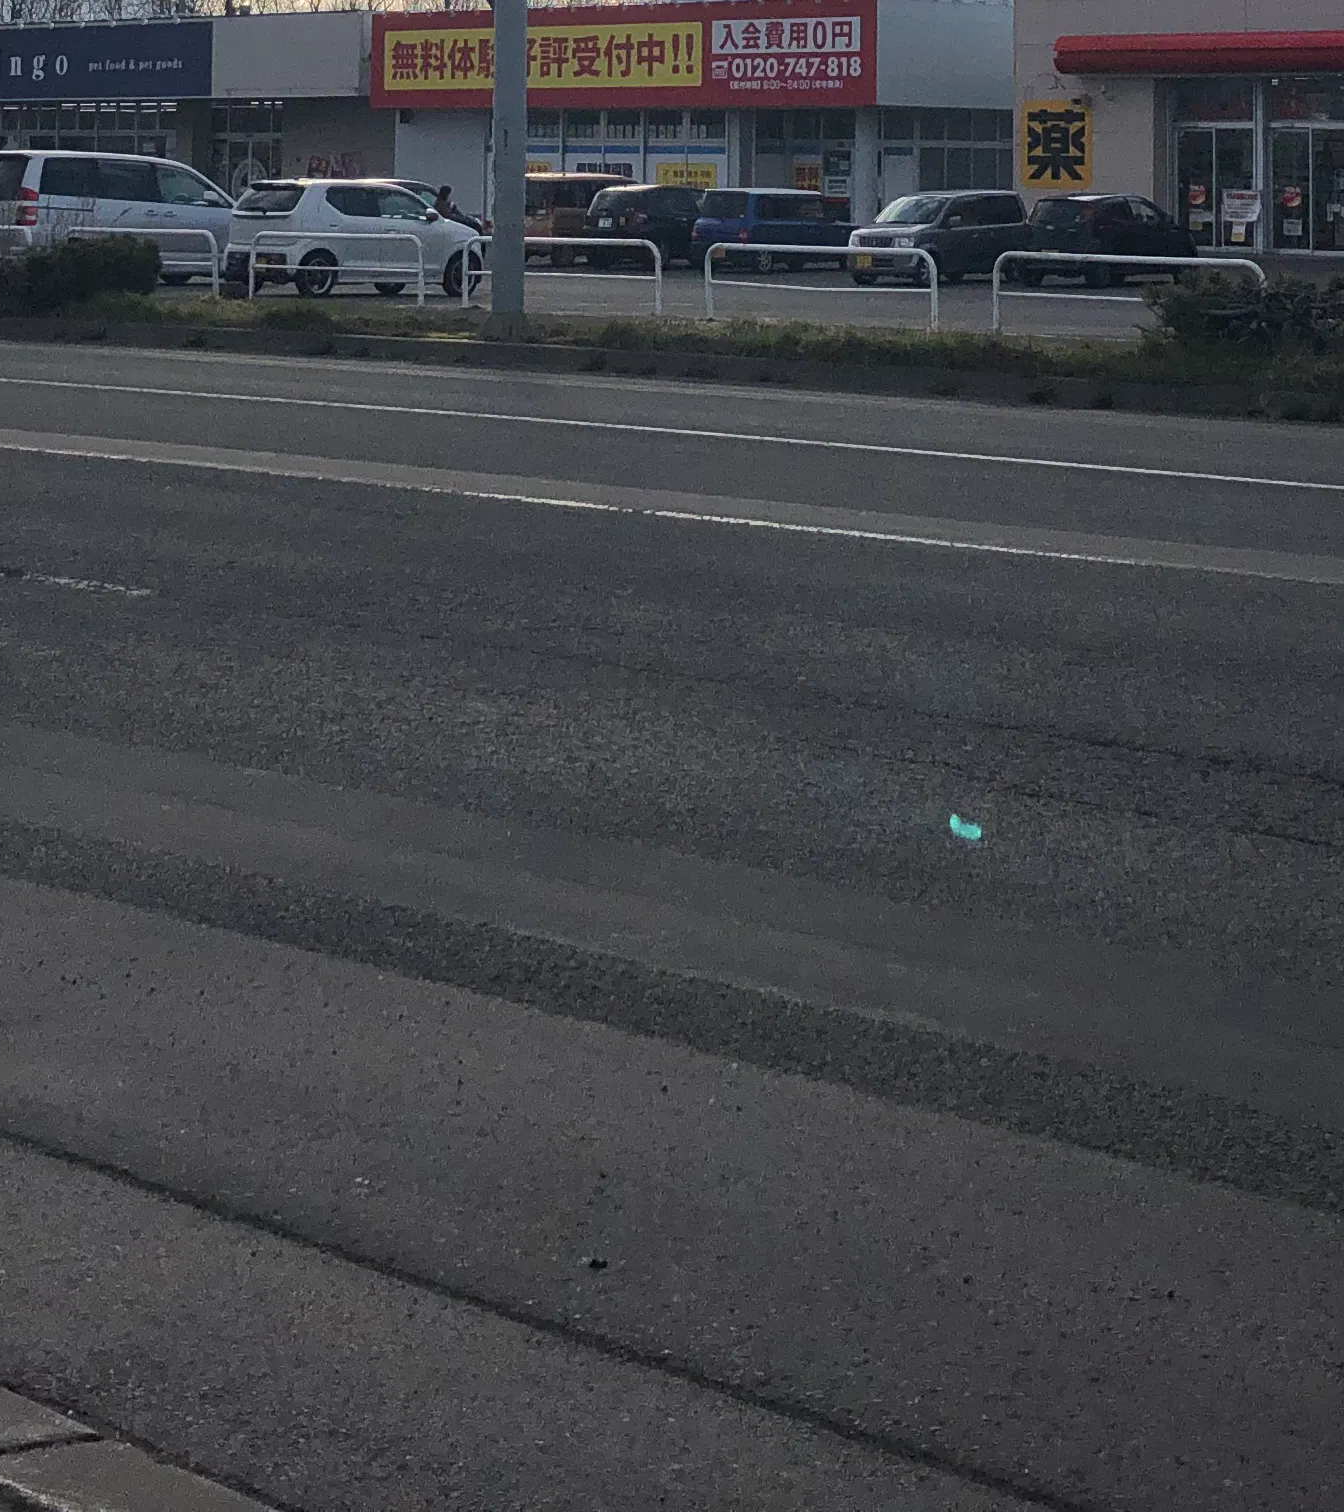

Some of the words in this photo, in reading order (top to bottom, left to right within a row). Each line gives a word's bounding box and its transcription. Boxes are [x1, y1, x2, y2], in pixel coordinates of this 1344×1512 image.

[718, 20, 854, 51] 入会費用0円
[731, 56, 862, 78] 0120-747-818
[1027, 107, 1086, 181] 薬
